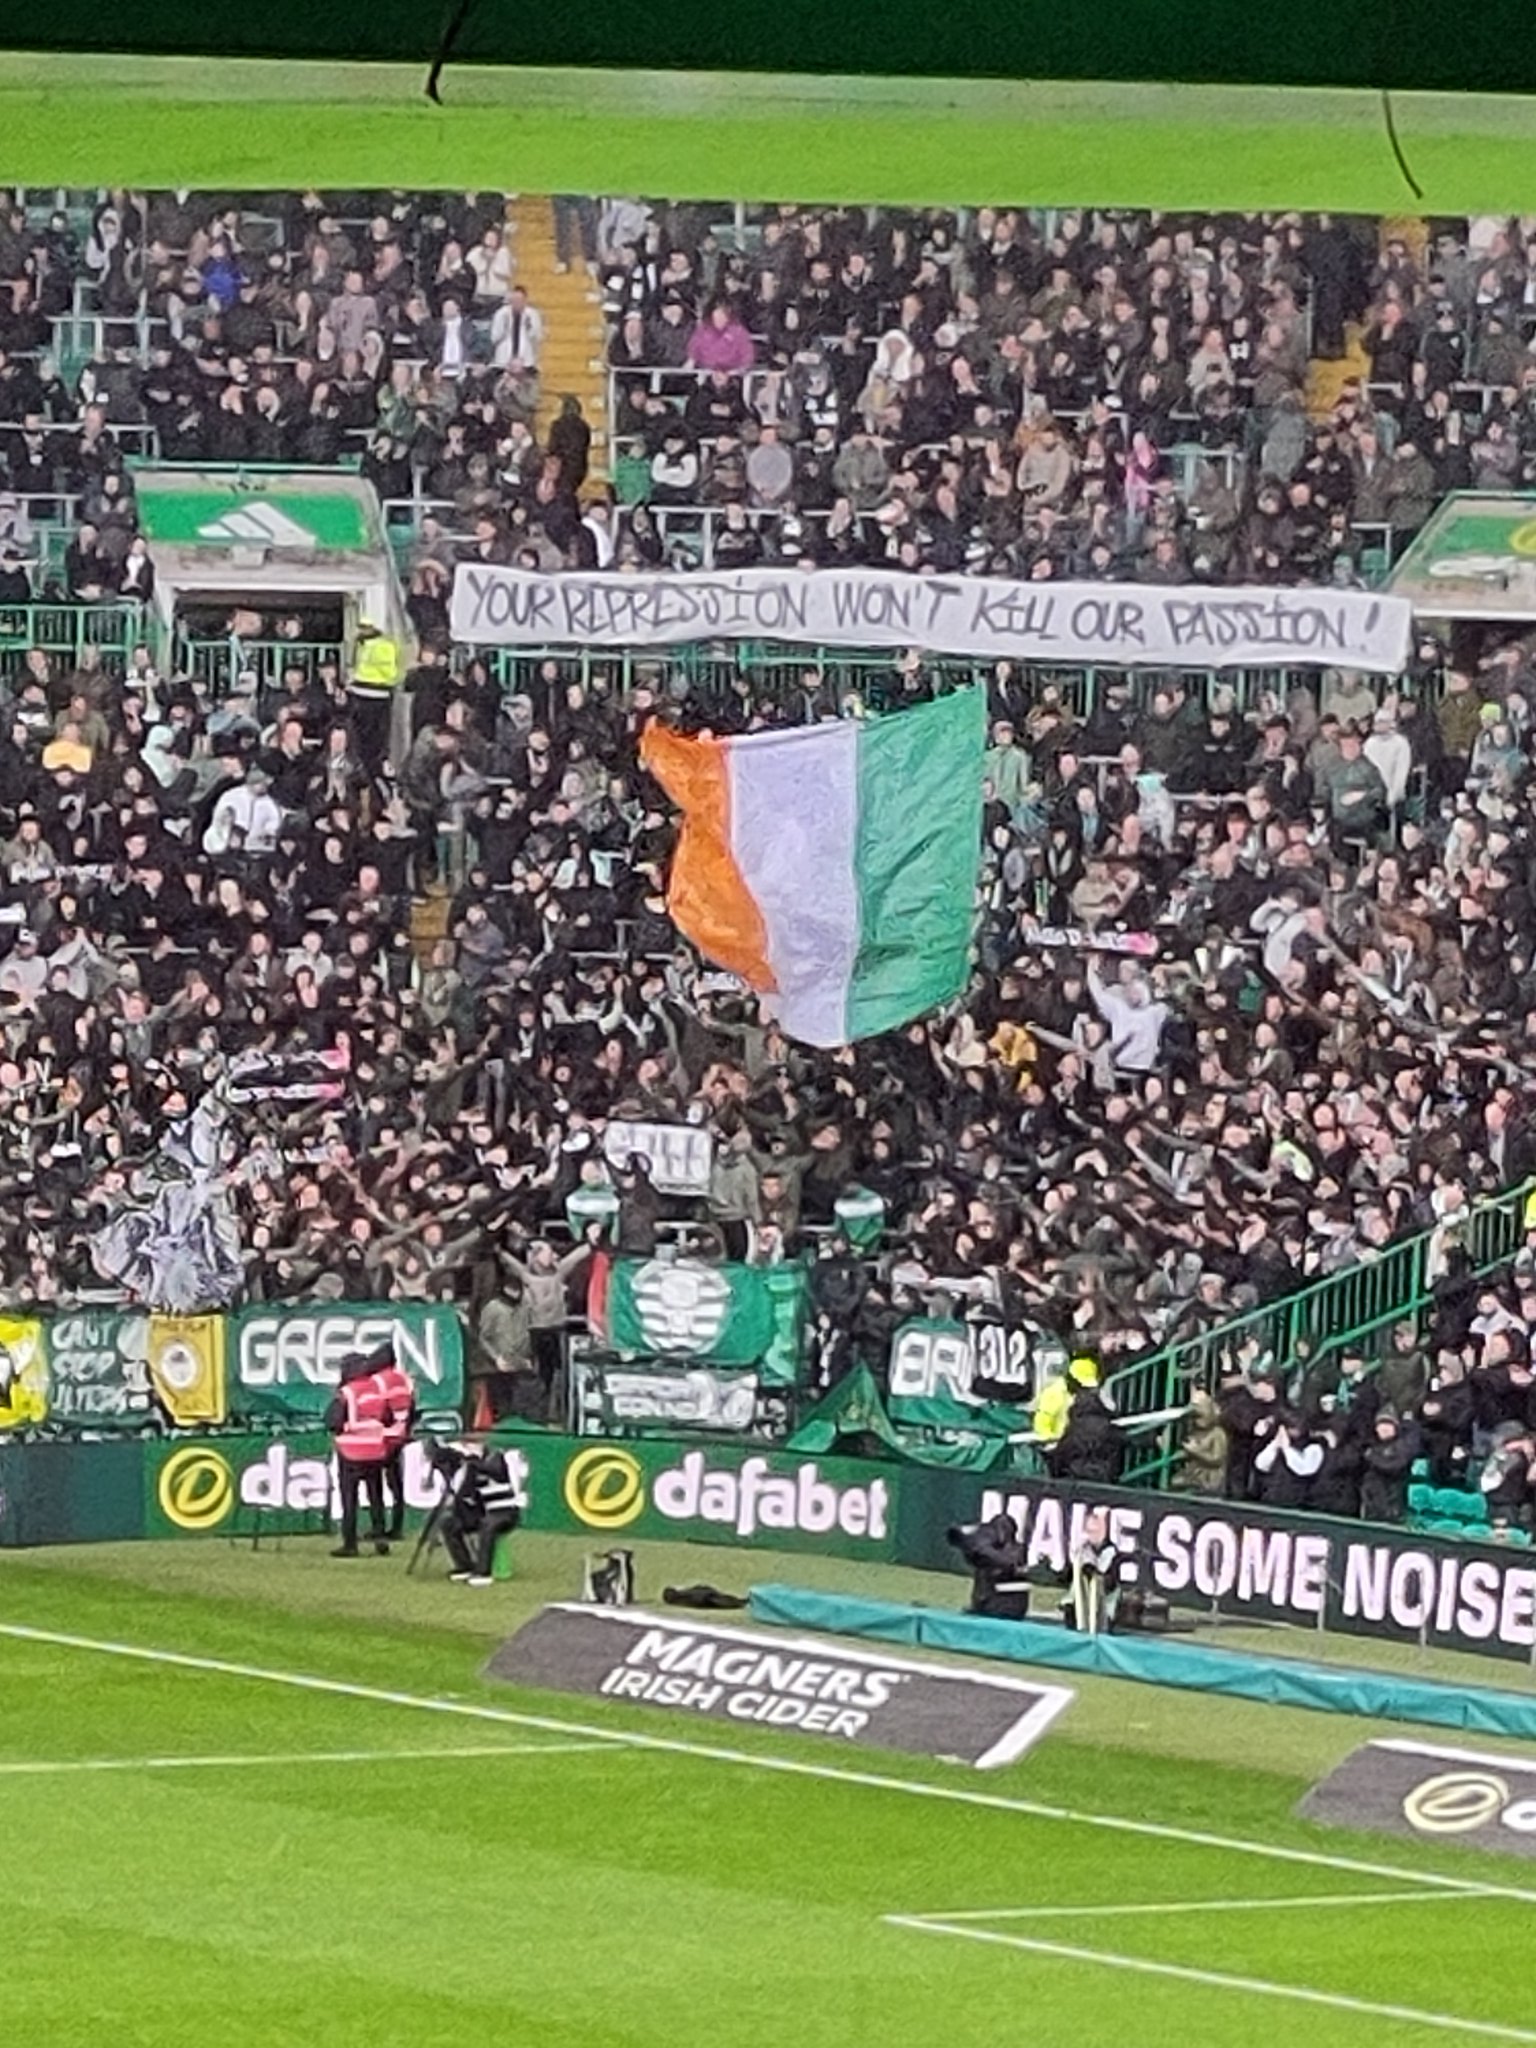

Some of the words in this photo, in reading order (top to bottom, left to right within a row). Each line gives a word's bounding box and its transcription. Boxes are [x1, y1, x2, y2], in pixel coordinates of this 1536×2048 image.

[467, 571, 555, 629] YOUR
[561, 577, 807, 635] REPRESSION
[833, 580, 962, 629] WON'T
[970, 586, 1059, 640] KILL
[1070, 599, 1146, 645] OUR
[653, 1452, 888, 1539] dafabet
[1153, 1514, 1329, 1612] SOME
[1342, 1543, 1536, 1646] NOISE
[600, 1667, 724, 1715] IRISH
[727, 1691, 870, 1743] CIDER
[625, 1630, 901, 1708] MAGNERS
